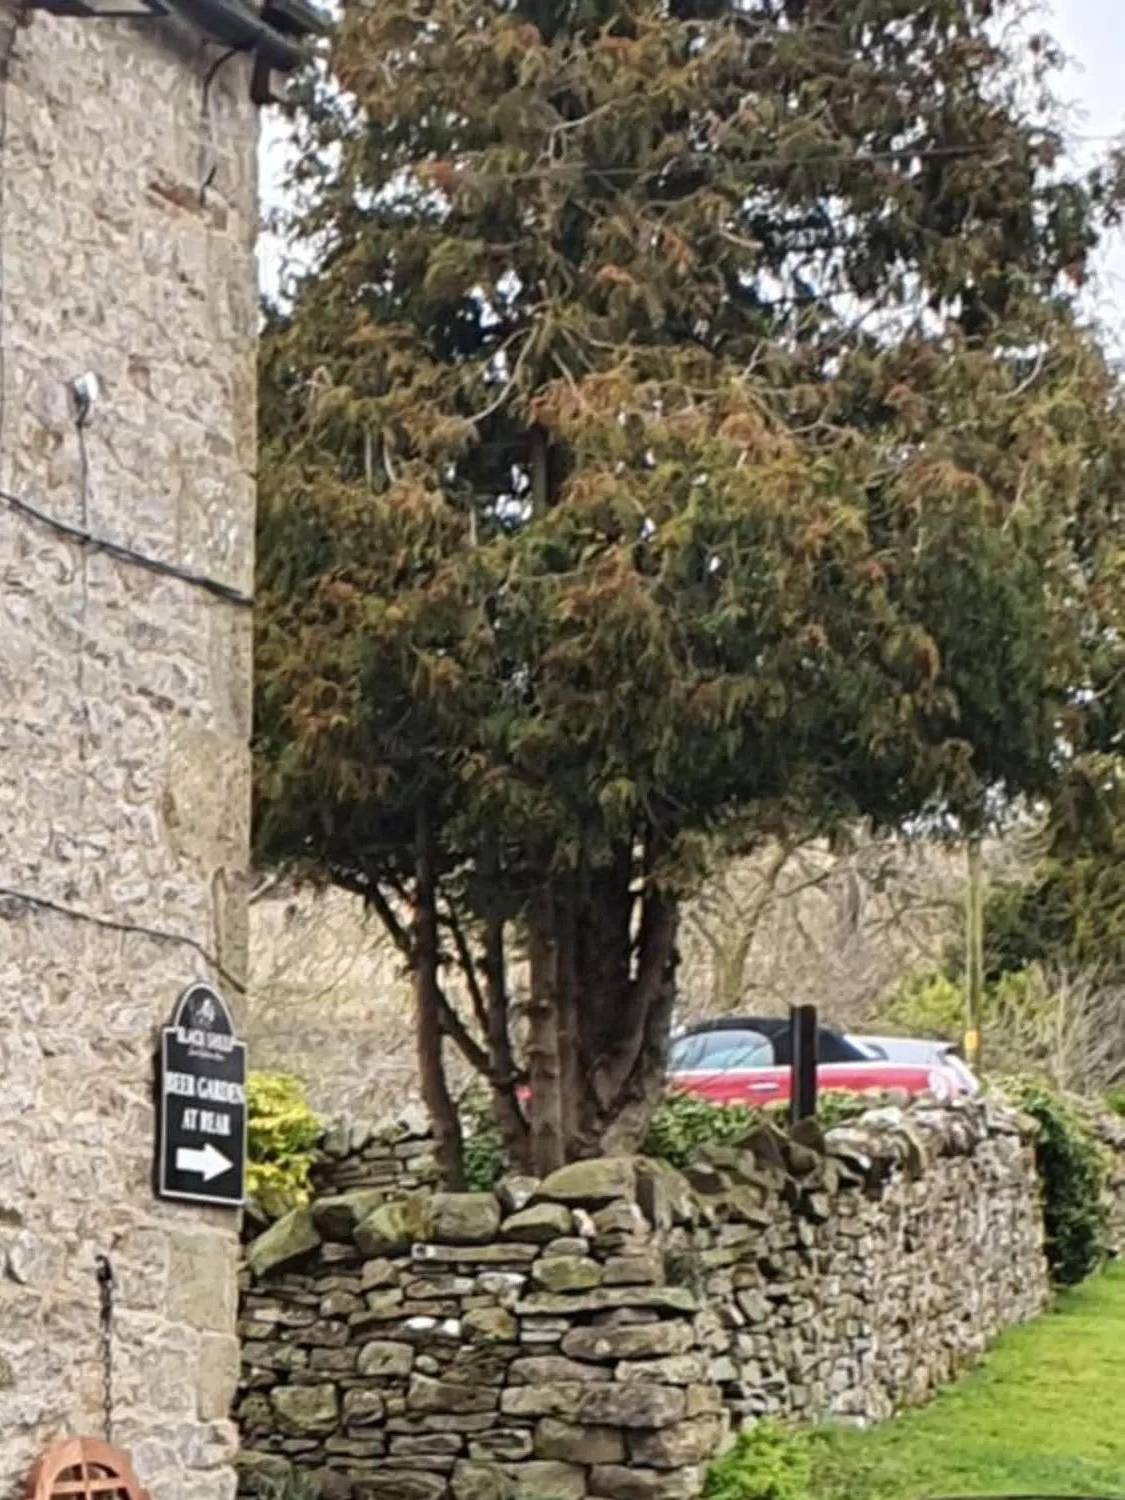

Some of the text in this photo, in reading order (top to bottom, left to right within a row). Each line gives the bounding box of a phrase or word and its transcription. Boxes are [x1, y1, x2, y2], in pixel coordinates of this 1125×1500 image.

[165, 1071, 244, 1104] BEER GARDEN
[181, 1108, 231, 1136] AT REAR
